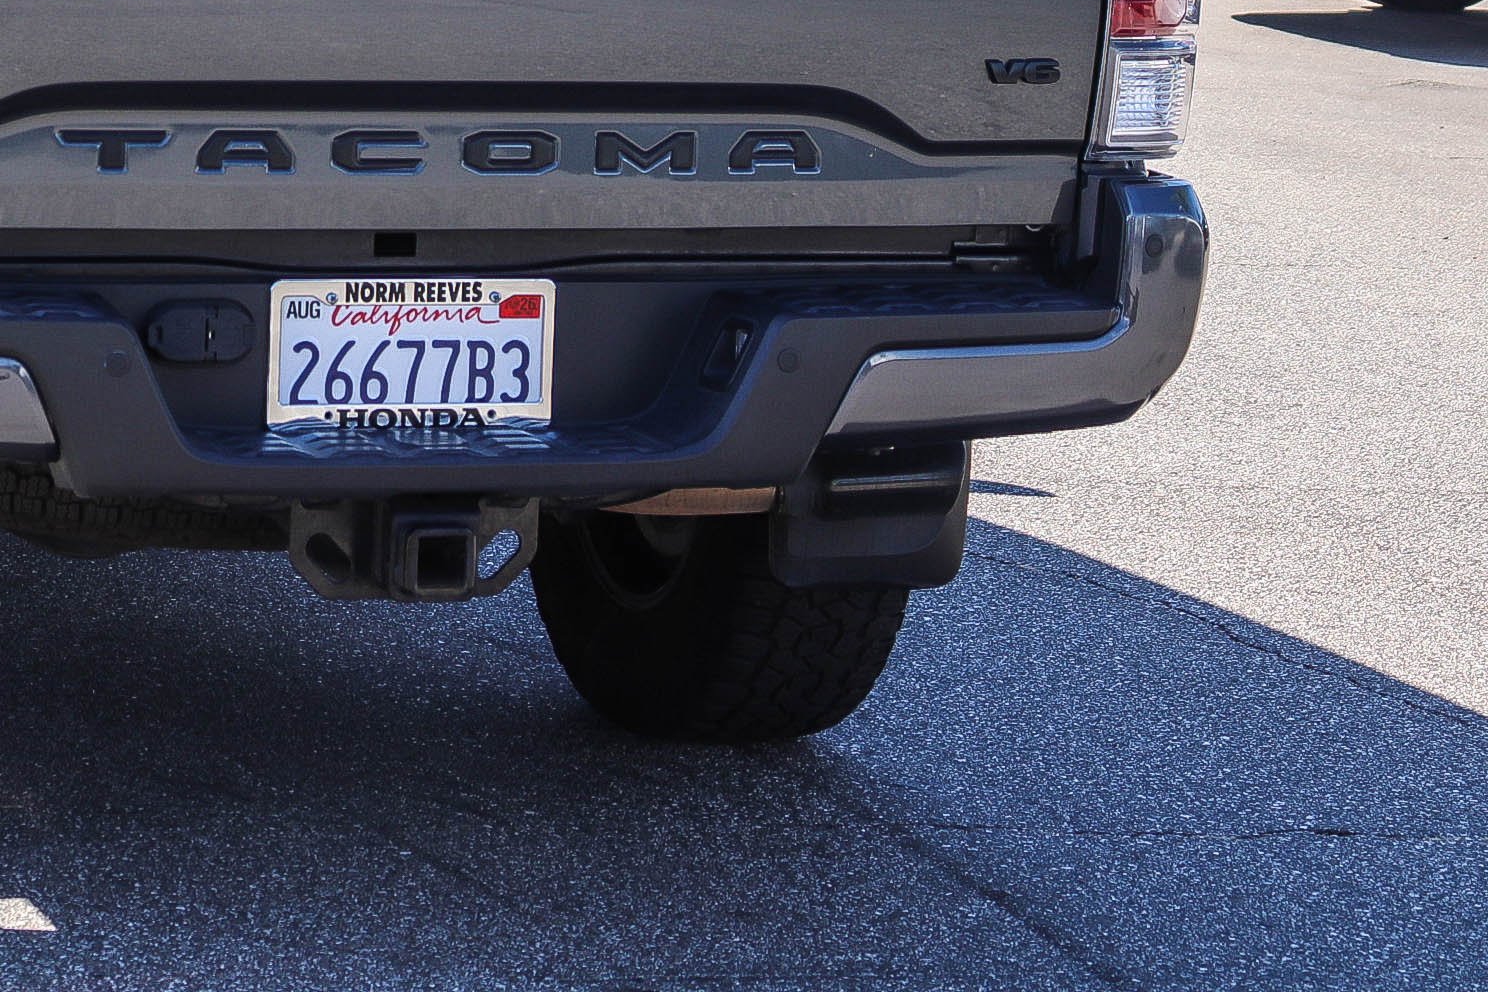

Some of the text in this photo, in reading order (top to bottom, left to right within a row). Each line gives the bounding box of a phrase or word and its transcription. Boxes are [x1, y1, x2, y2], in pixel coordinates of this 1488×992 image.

[984, 58, 1061, 85] V6
[55, 129, 823, 176] TACOMA
[345, 281, 483, 303] NORM REEVES
[286, 302, 321, 319] AUG
[330, 305, 500, 336] California
[289, 340, 530, 405] 26677B3
[336, 408, 488, 429] HONDA
